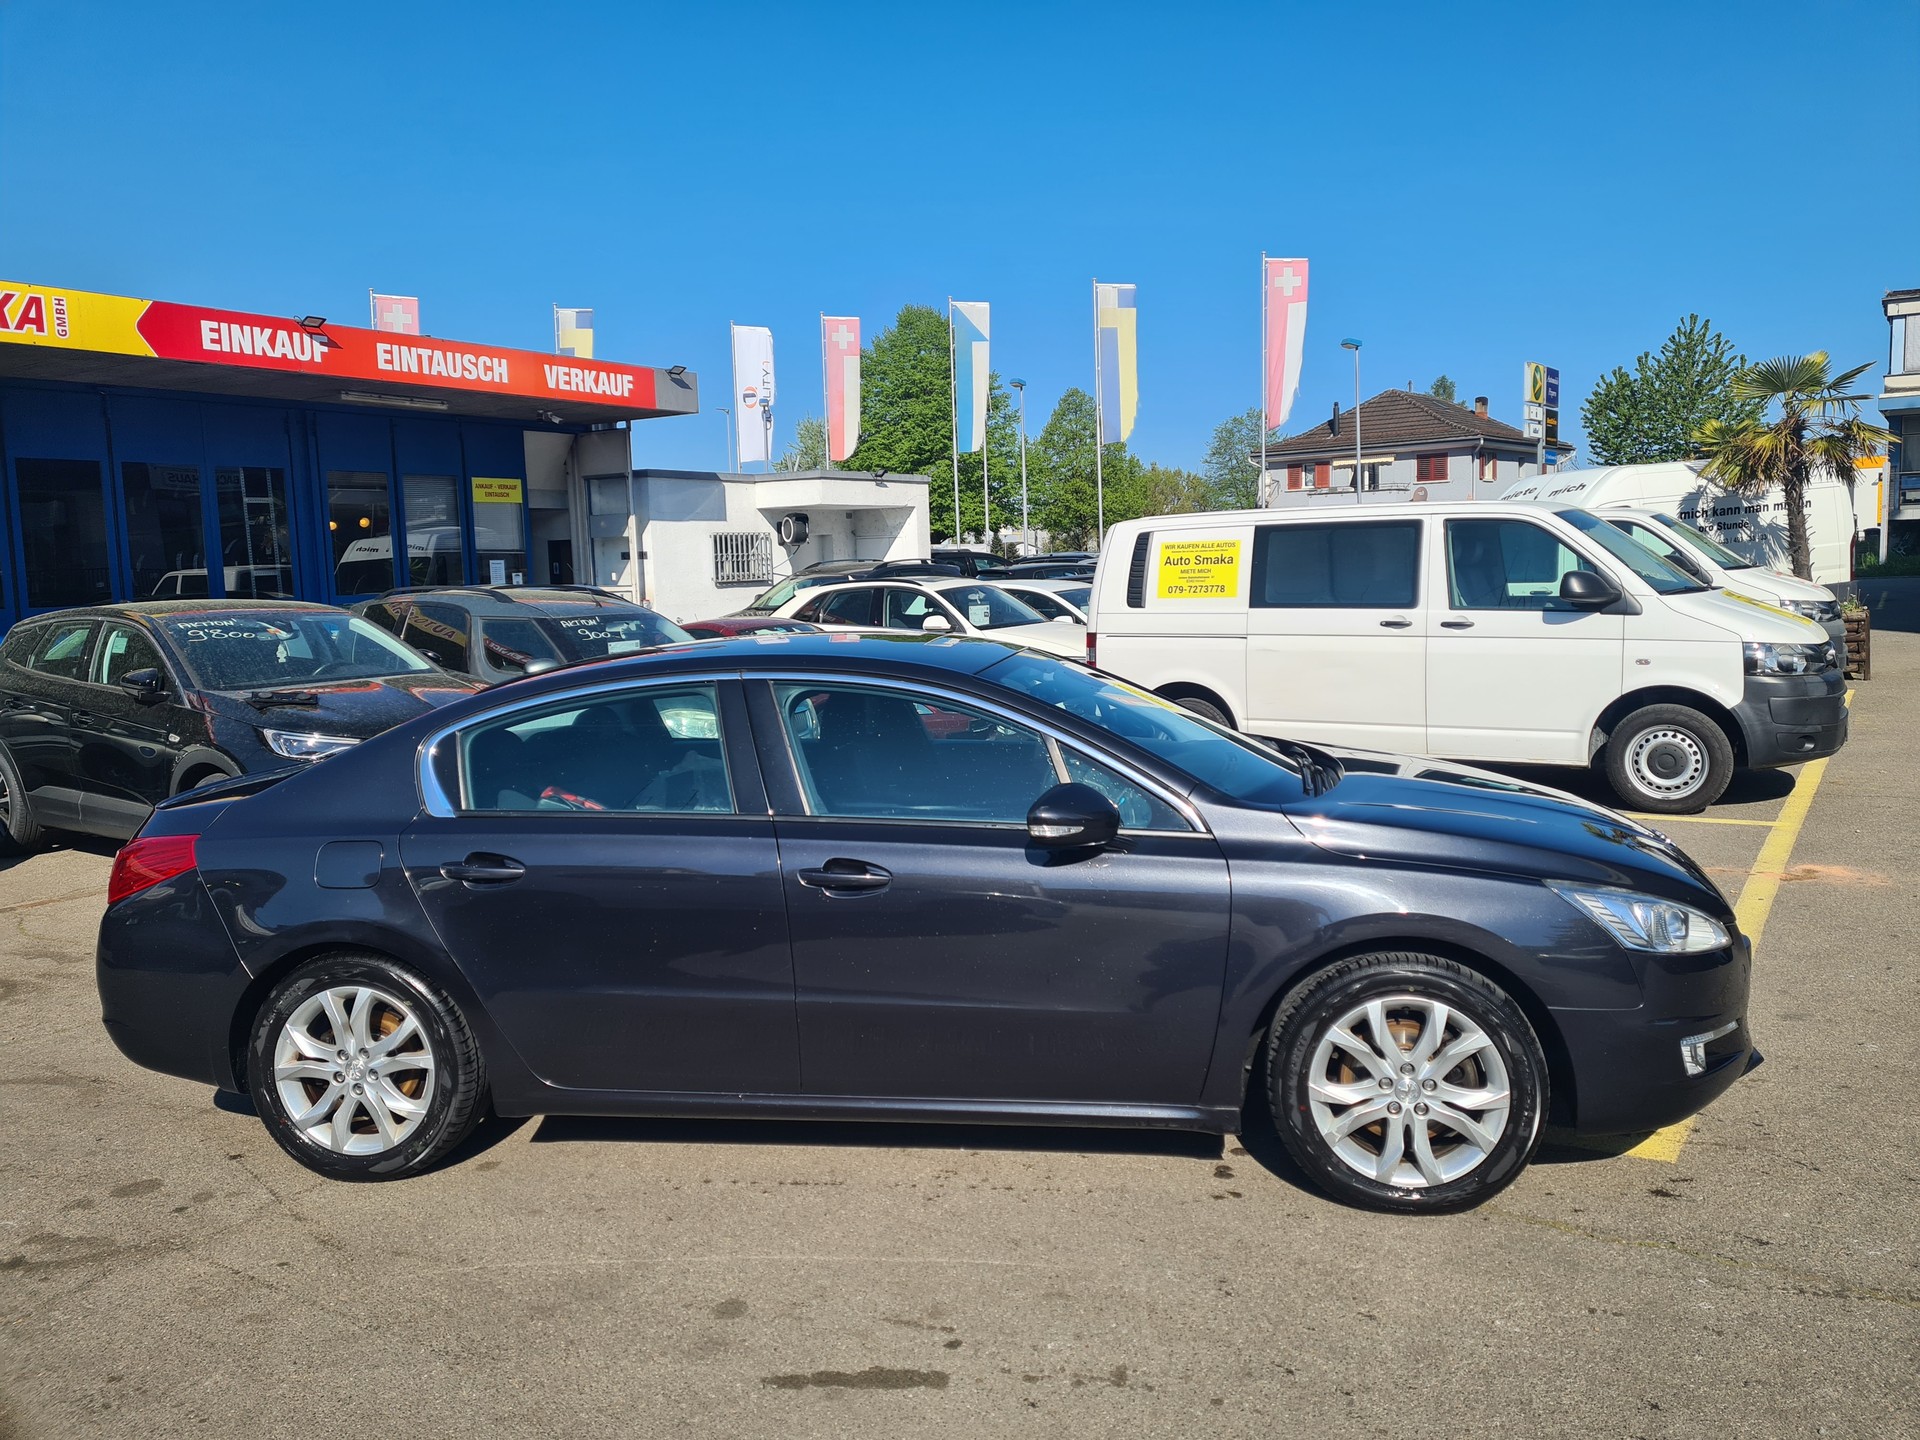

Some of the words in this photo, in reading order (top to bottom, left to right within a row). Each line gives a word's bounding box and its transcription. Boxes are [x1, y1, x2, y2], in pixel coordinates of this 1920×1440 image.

[53, 297, 68, 338] GMBH
[200, 319, 329, 363] EINKAUF
[376, 342, 509, 384] EINTAUSCH
[543, 364, 634, 397] VERKAUF
[1548, 482, 1587, 497] mich
[1680, 507, 1709, 520] mich
[1712, 505, 1741, 517] kann
[1745, 502, 1769, 514] man
[1717, 520, 1749, 531] Stunde
[1164, 556, 1191, 566] Auto
[1194, 553, 1234, 566] Smaka
[1167, 585, 1226, 594] 079-7273778
